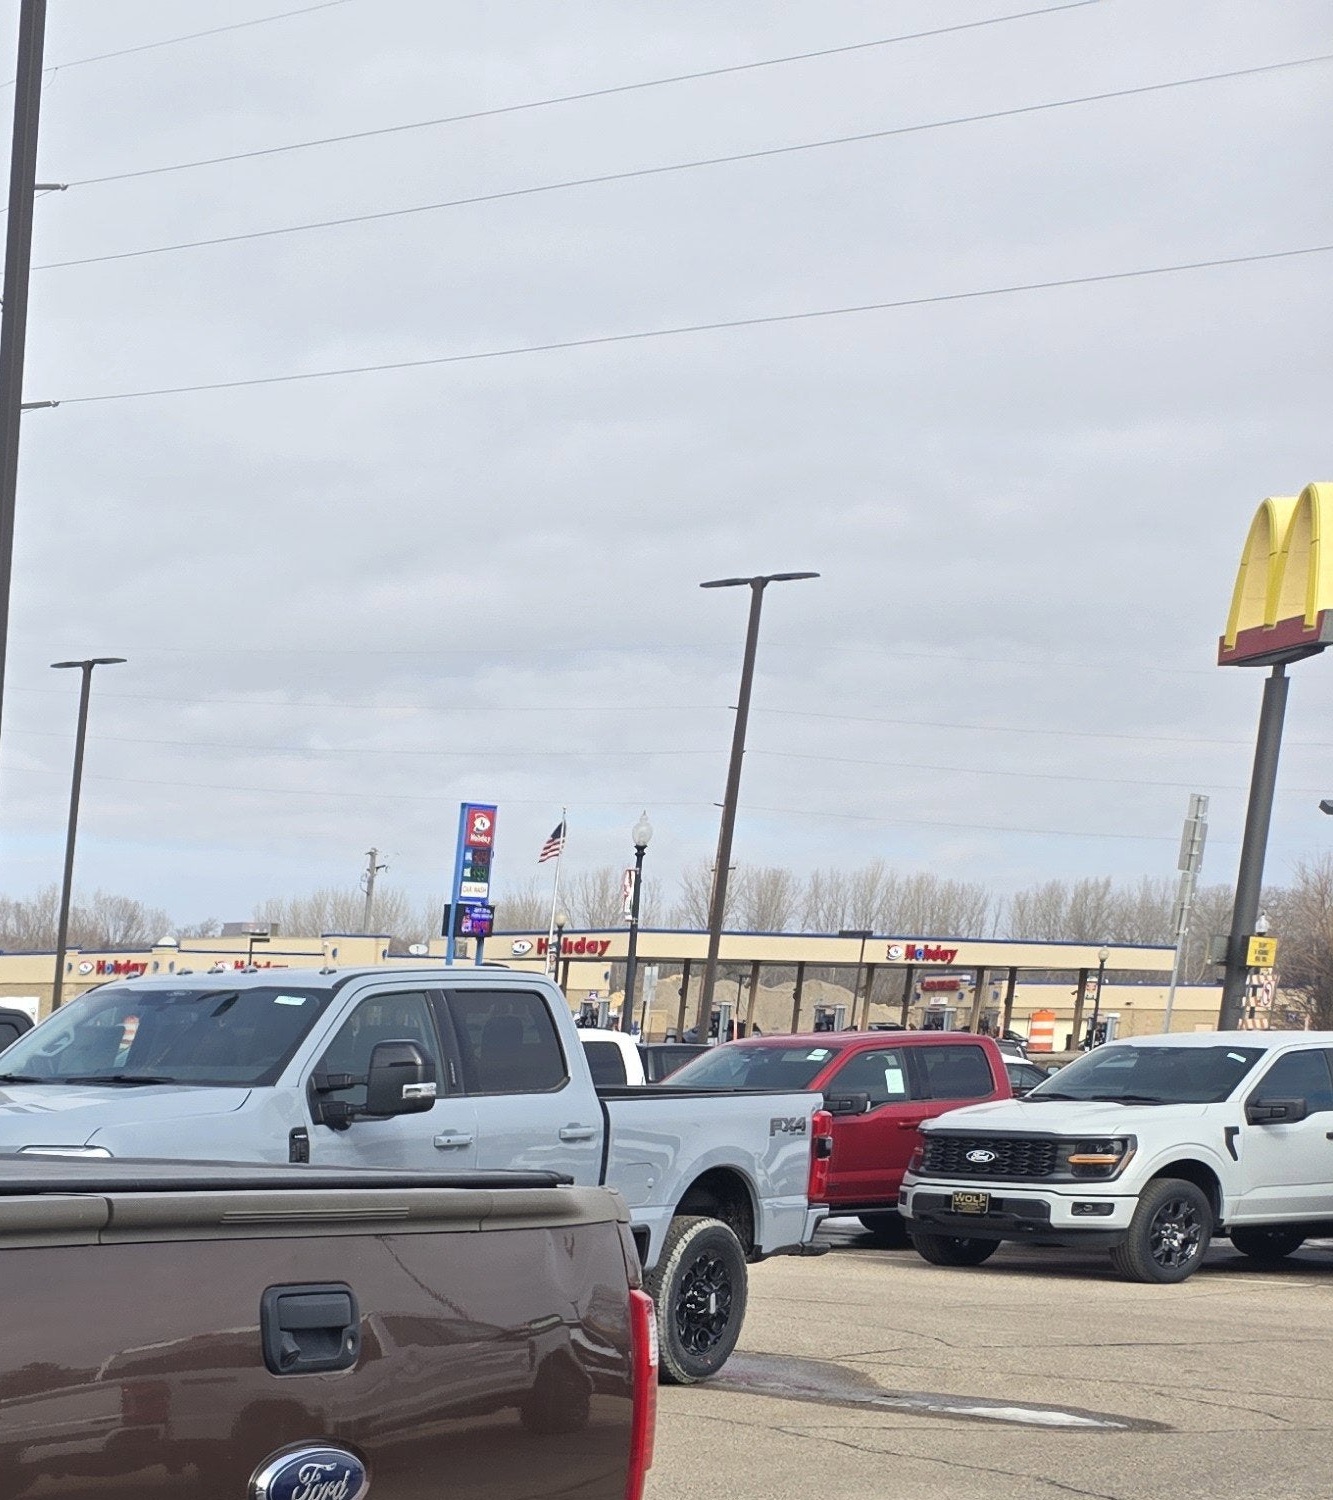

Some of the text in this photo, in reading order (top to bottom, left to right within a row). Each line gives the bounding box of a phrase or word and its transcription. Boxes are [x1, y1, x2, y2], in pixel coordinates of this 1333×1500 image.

[536, 937, 611, 957] Hliday
[905, 944, 958, 964] Holiday
[96, 960, 149, 975] Holiday
[769, 1116, 807, 1136] FX4
[955, 1192, 987, 1202] WOLF
